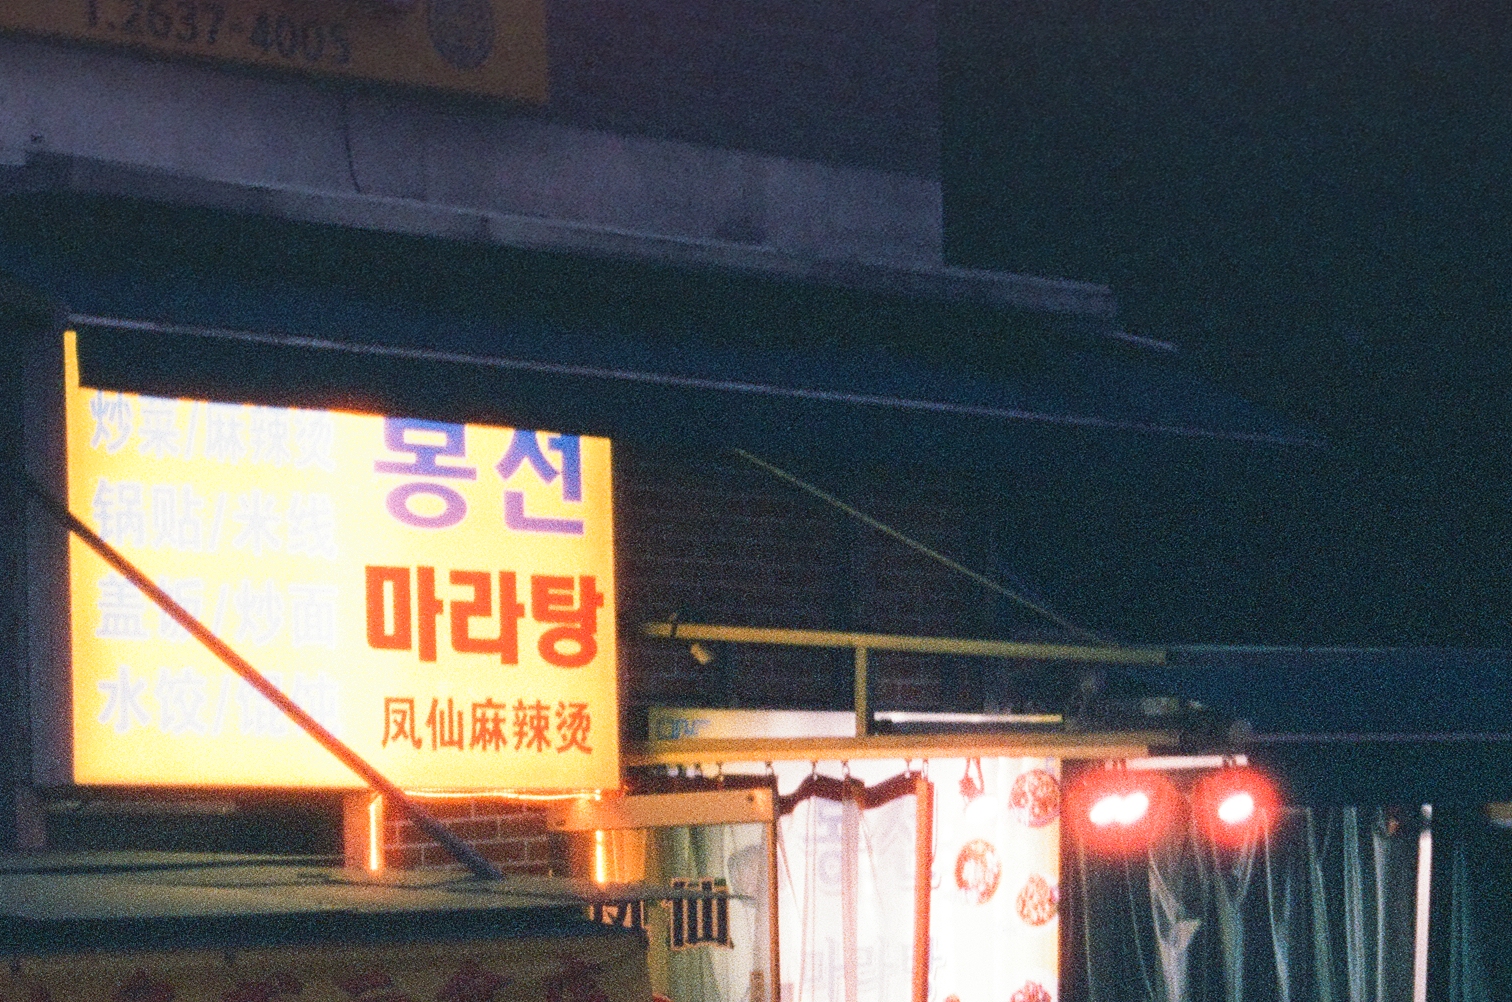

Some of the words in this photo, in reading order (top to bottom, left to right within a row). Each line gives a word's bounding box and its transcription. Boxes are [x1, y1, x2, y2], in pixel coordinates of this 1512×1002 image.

[372, 416, 585, 537] 봉선
[364, 565, 605, 669] 마라탕
[381, 697, 594, 756] 凤仙麻辣烫
